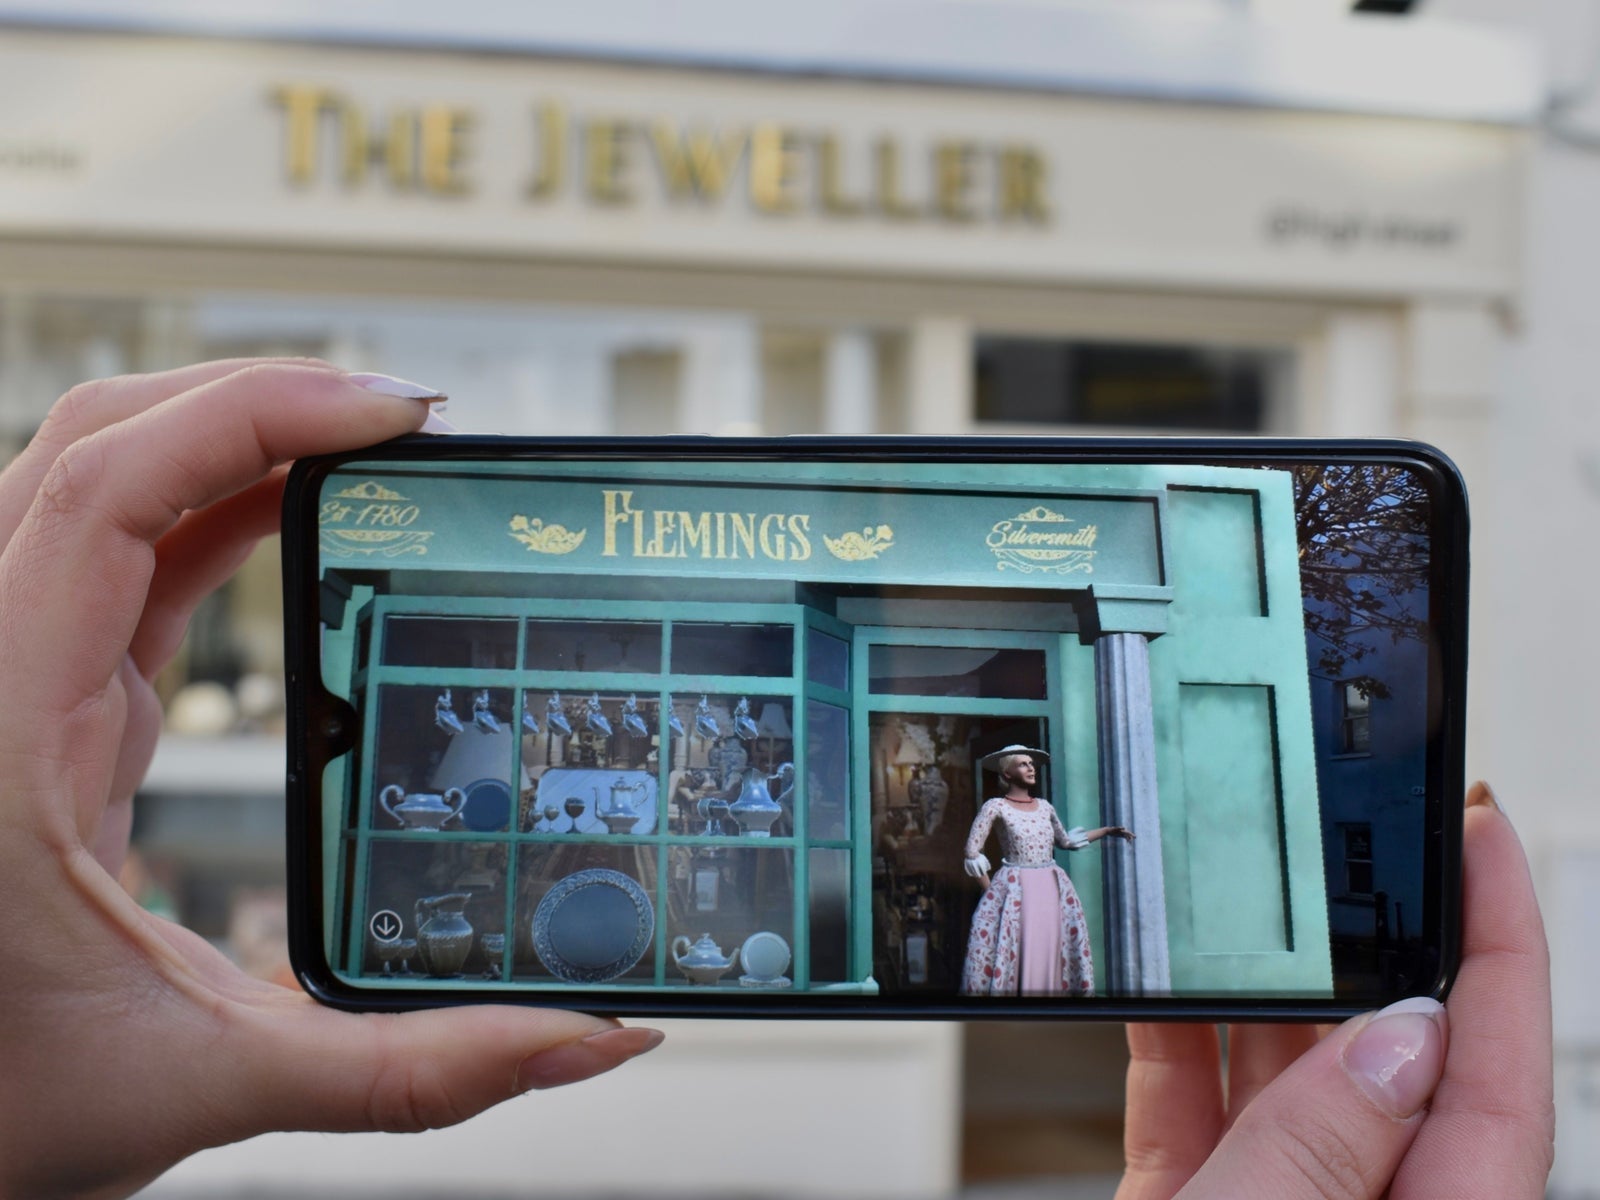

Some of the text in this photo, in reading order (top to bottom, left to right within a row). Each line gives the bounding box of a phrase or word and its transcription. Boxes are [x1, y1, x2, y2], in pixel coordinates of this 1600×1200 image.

[268, 86, 1051, 226] THE JEWELLER
[355, 504, 421, 526] 1780
[602, 489, 812, 561] FLEMINGS
[986, 520, 1097, 548] Silversmith
